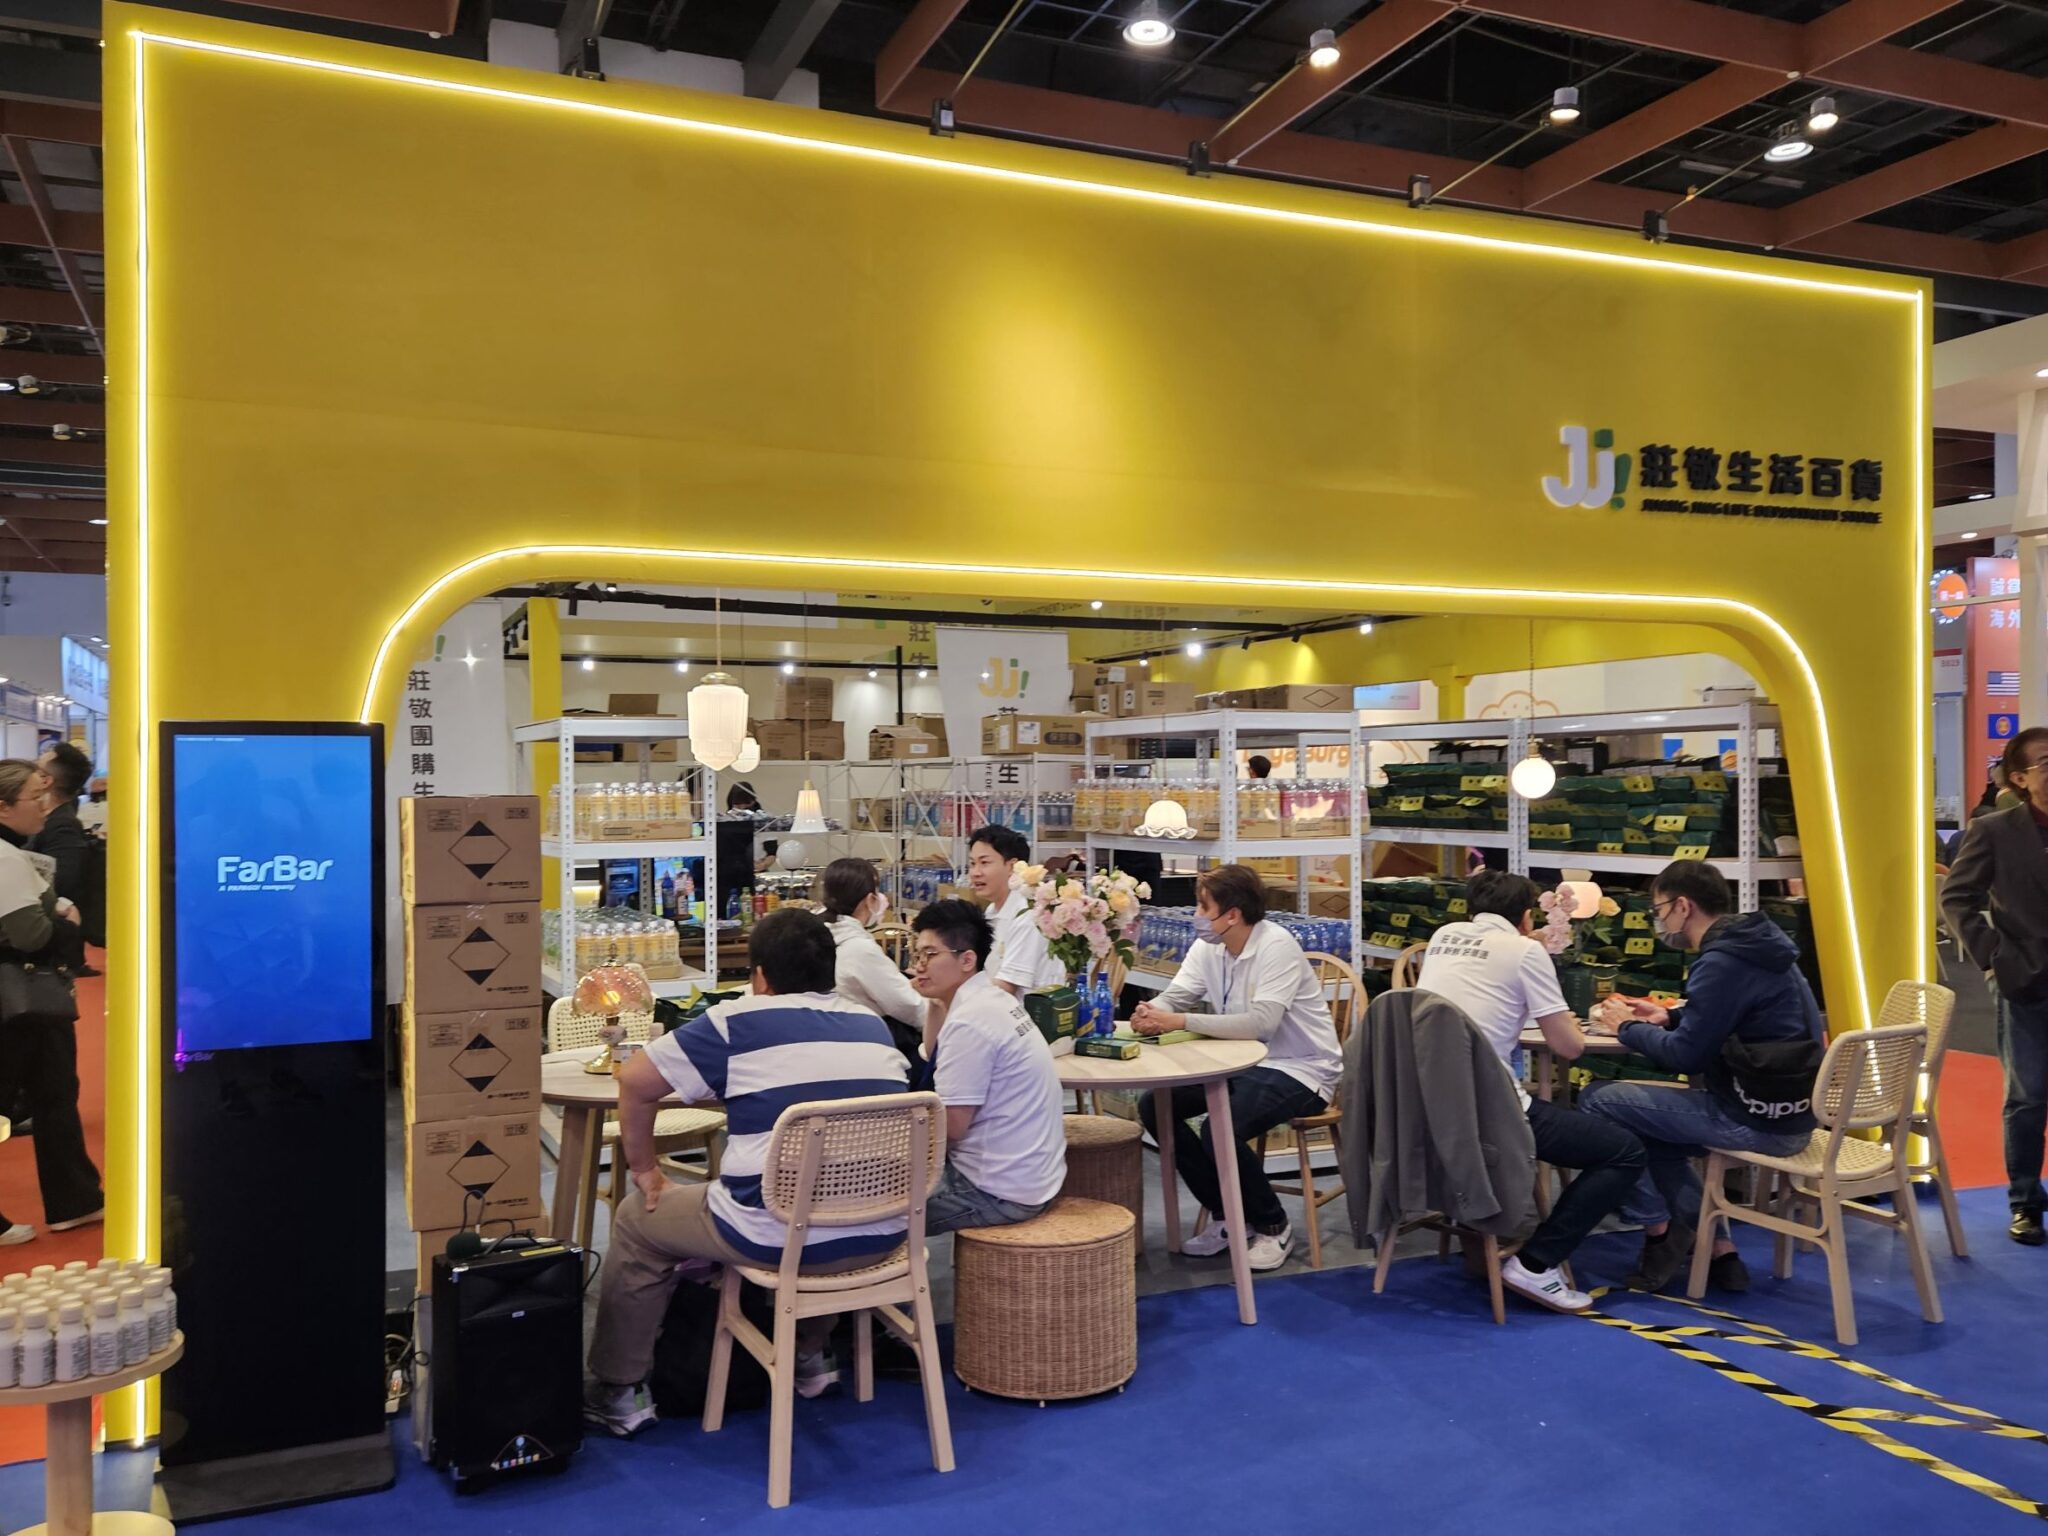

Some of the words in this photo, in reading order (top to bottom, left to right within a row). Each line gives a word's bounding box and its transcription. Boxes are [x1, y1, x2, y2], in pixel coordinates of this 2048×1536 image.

[1640, 444, 1882, 501] 莊敬生活百貨
[218, 855, 334, 883] FarBar
